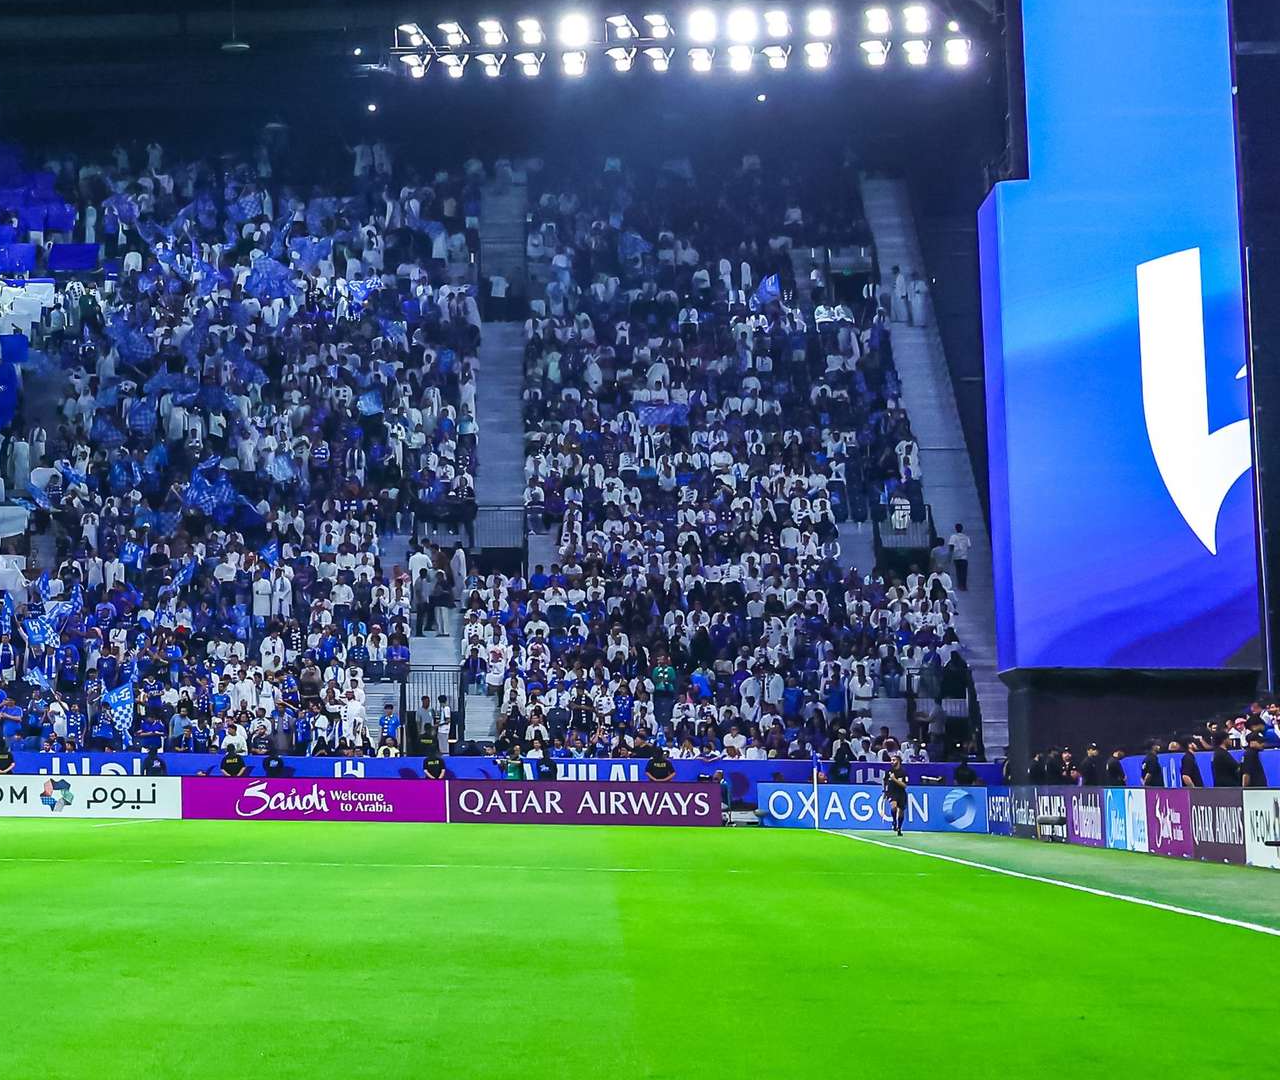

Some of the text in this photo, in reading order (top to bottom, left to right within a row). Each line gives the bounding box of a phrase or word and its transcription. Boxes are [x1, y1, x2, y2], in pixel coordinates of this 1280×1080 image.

[86, 783, 157, 810] نيوم
[235, 780, 330, 817] Saudi
[330, 790, 384, 802] Welcome
[340, 801, 393, 813] to Arabia
[458, 789, 710, 817] QATAR AIRWAYS
